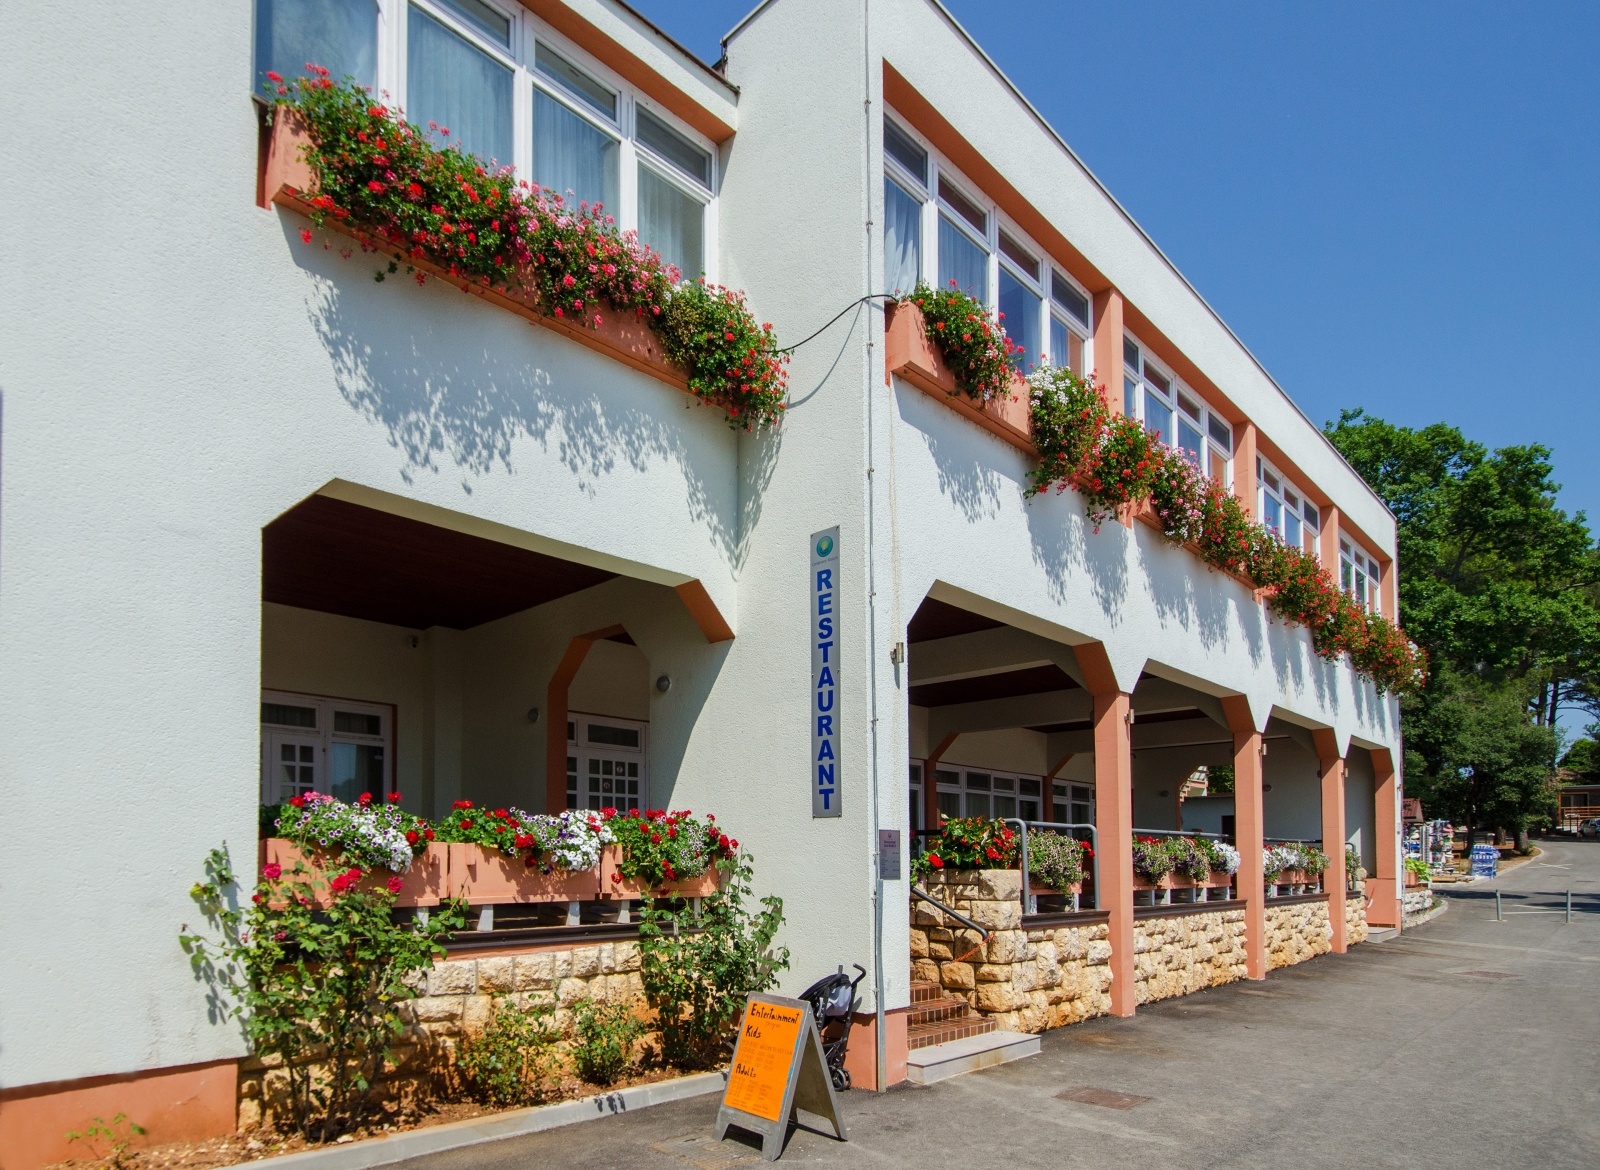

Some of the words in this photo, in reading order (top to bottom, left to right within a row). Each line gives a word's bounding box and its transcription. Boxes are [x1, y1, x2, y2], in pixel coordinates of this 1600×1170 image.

[816, 568, 835, 810] RESTAURANT
[751, 1003, 800, 1024] Entertainment
[745, 1025, 761, 1038] Kids
[735, 1063, 756, 1078] Adults
